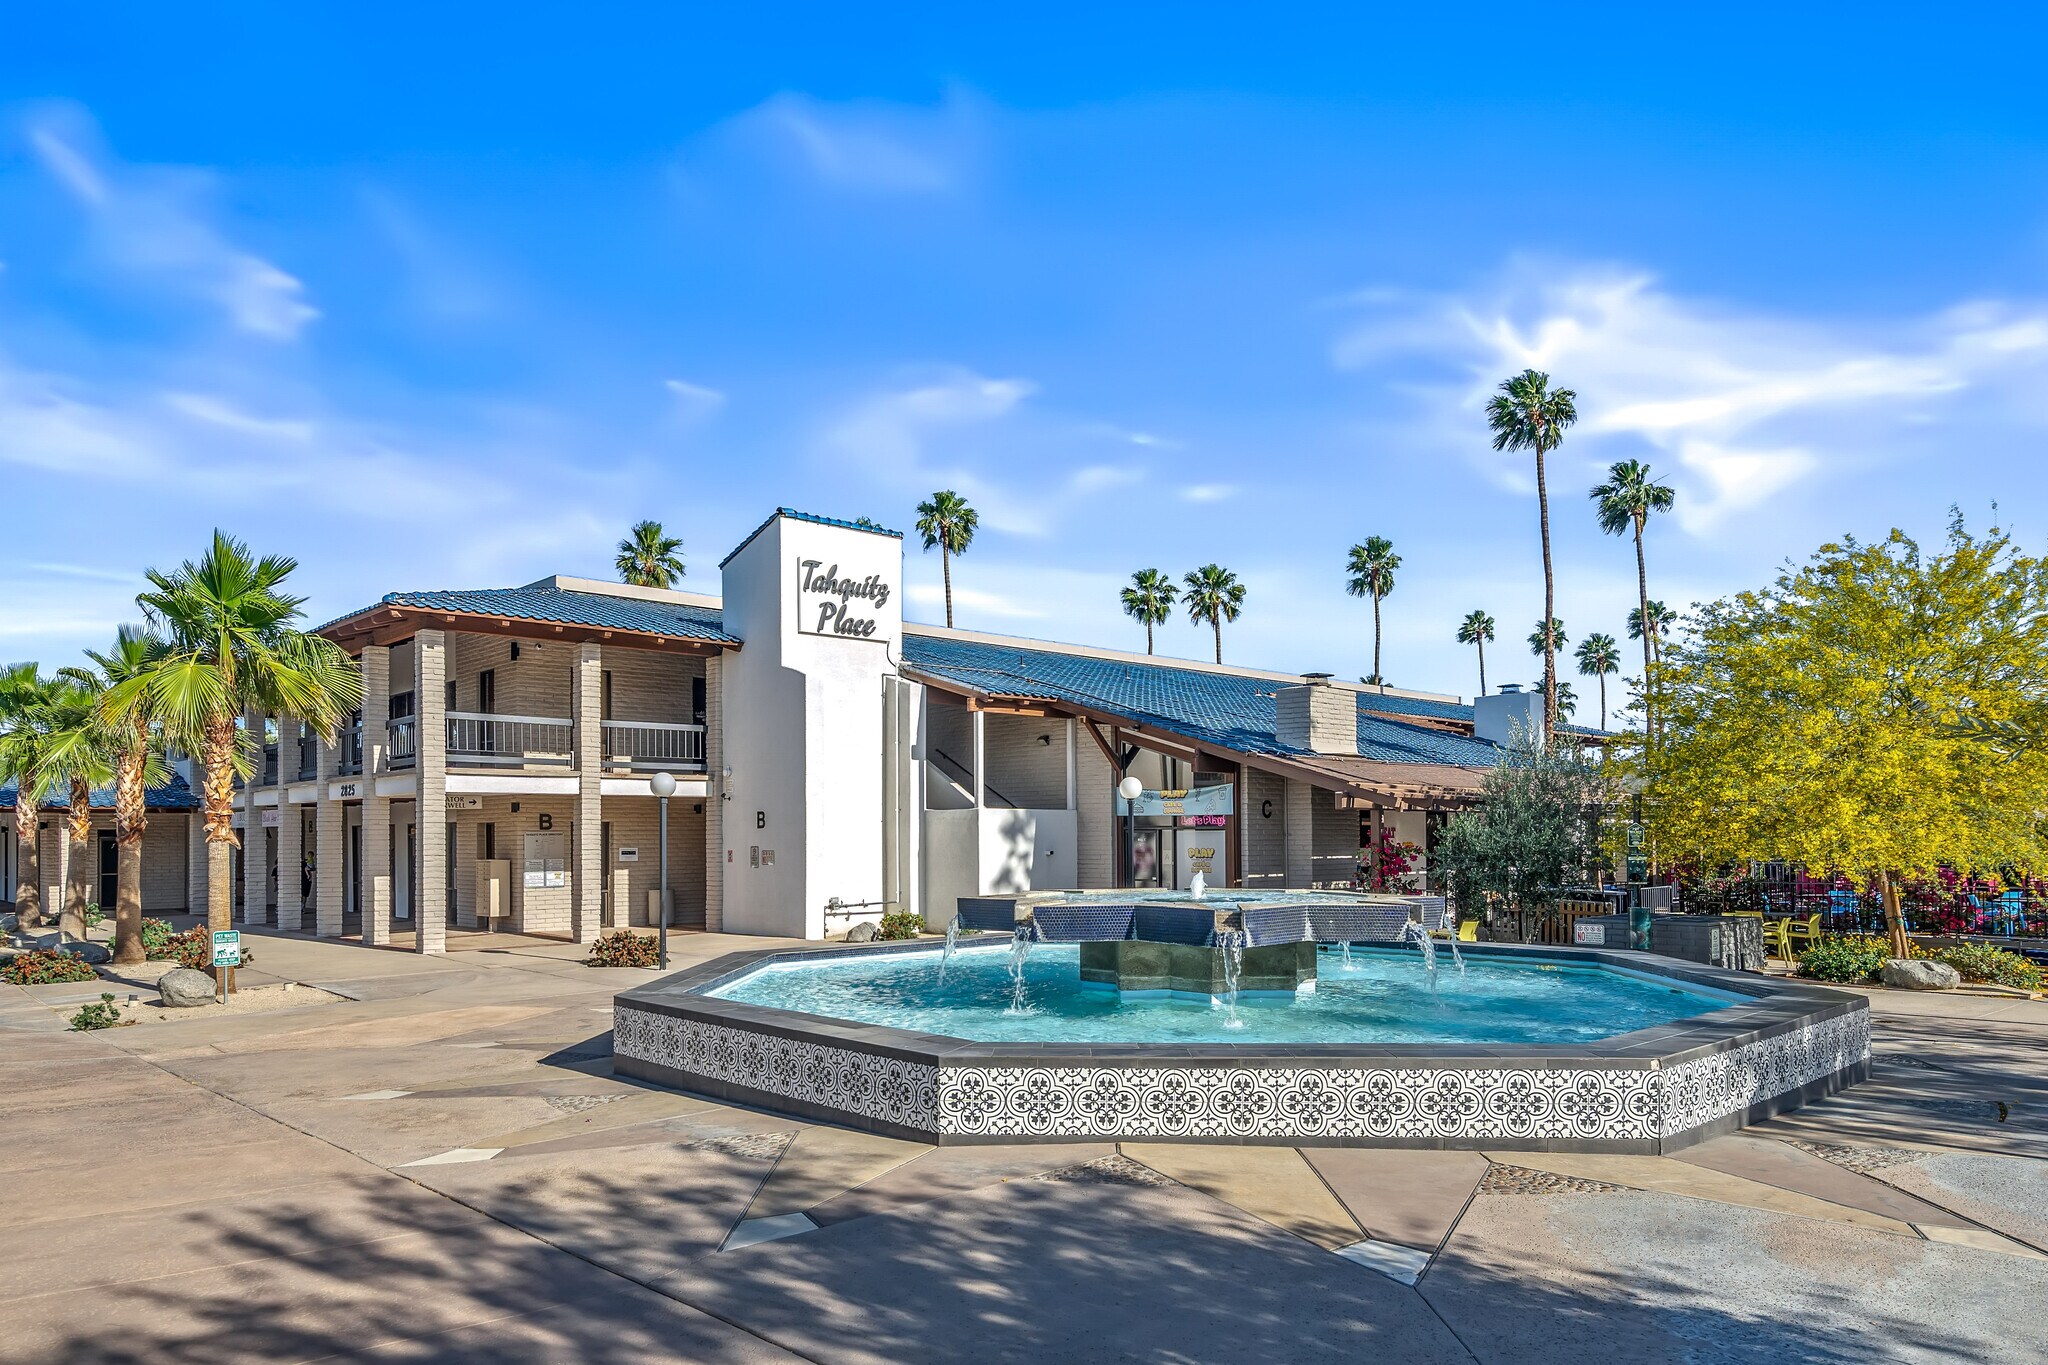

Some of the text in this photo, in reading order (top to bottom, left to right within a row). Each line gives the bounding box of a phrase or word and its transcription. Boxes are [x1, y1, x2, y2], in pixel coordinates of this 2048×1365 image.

[802, 560, 890, 609] Tahquitz
[817, 602, 876, 637] Place
[340, 784, 356, 797] 2825
[1160, 789, 1188, 799] PLAY
[1262, 800, 1272, 819] C
[540, 814, 553, 830] B
[757, 811, 766, 829] B
[1181, 815, 1226, 826] Let's Play!
[1188, 848, 1215, 858] PLAY
[1577, 931, 1585, 941] NO
